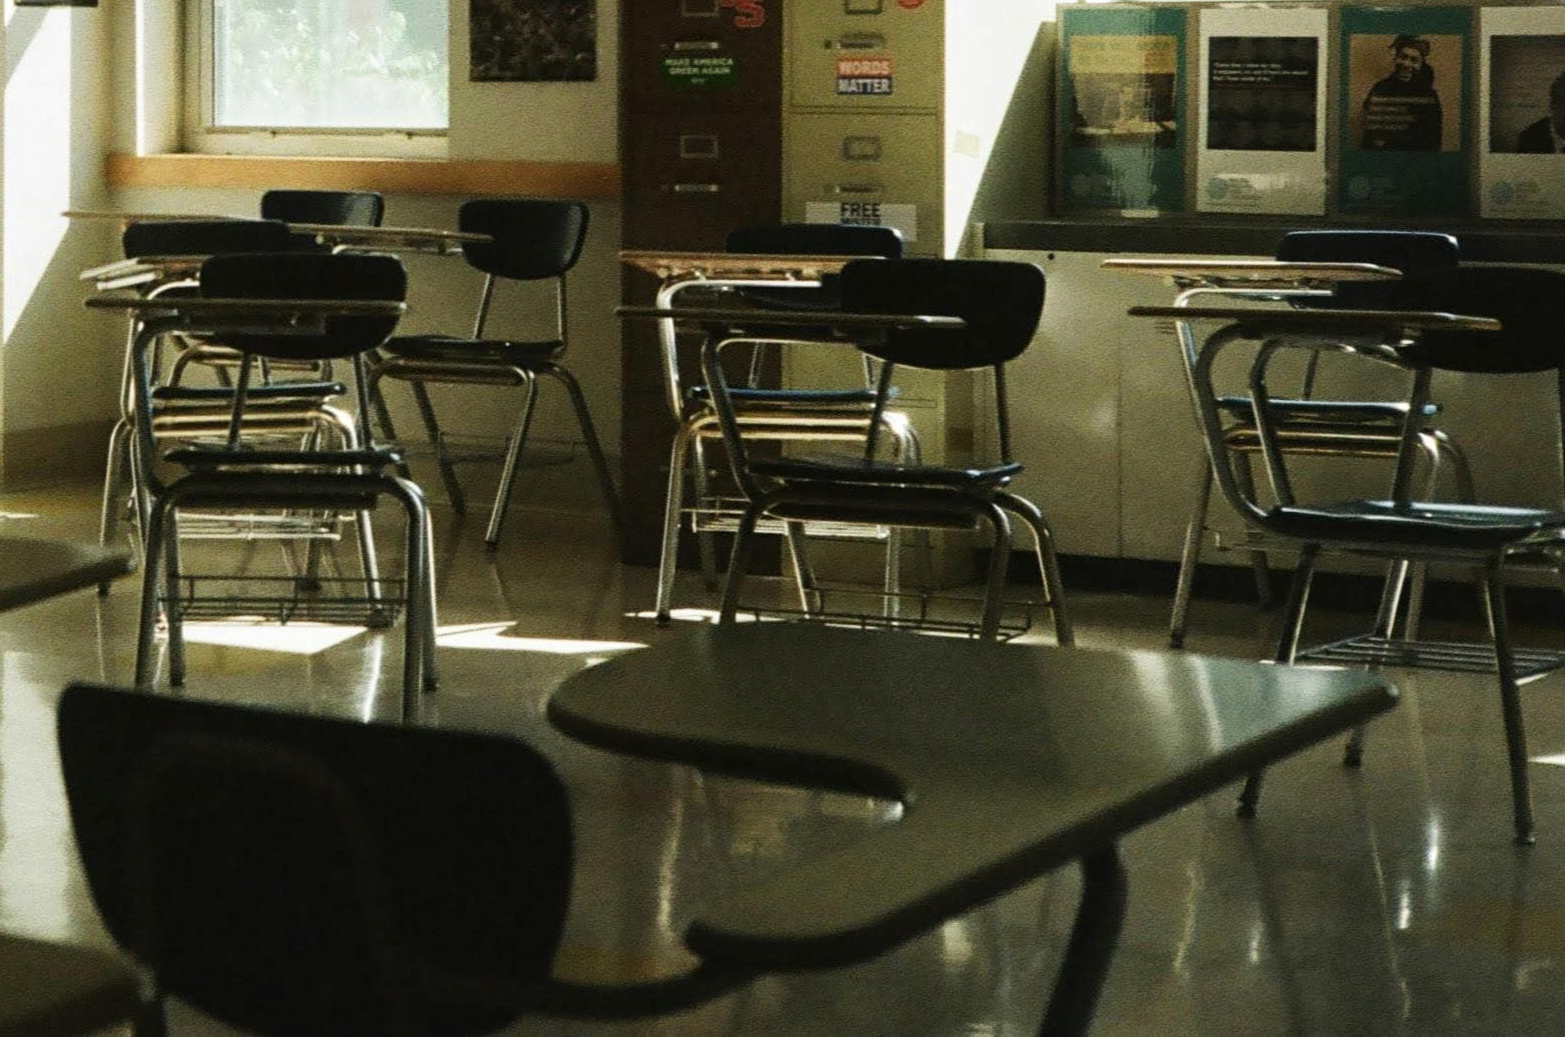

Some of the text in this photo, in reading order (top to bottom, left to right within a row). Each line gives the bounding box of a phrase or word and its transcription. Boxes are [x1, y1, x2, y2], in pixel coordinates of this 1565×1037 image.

[692, 57, 734, 66] AMERICA
[838, 60, 890, 75] WORDS
[701, 66, 731, 75] AGAIN
[837, 77, 890, 93] MATTER
[841, 202, 882, 219] FREE
